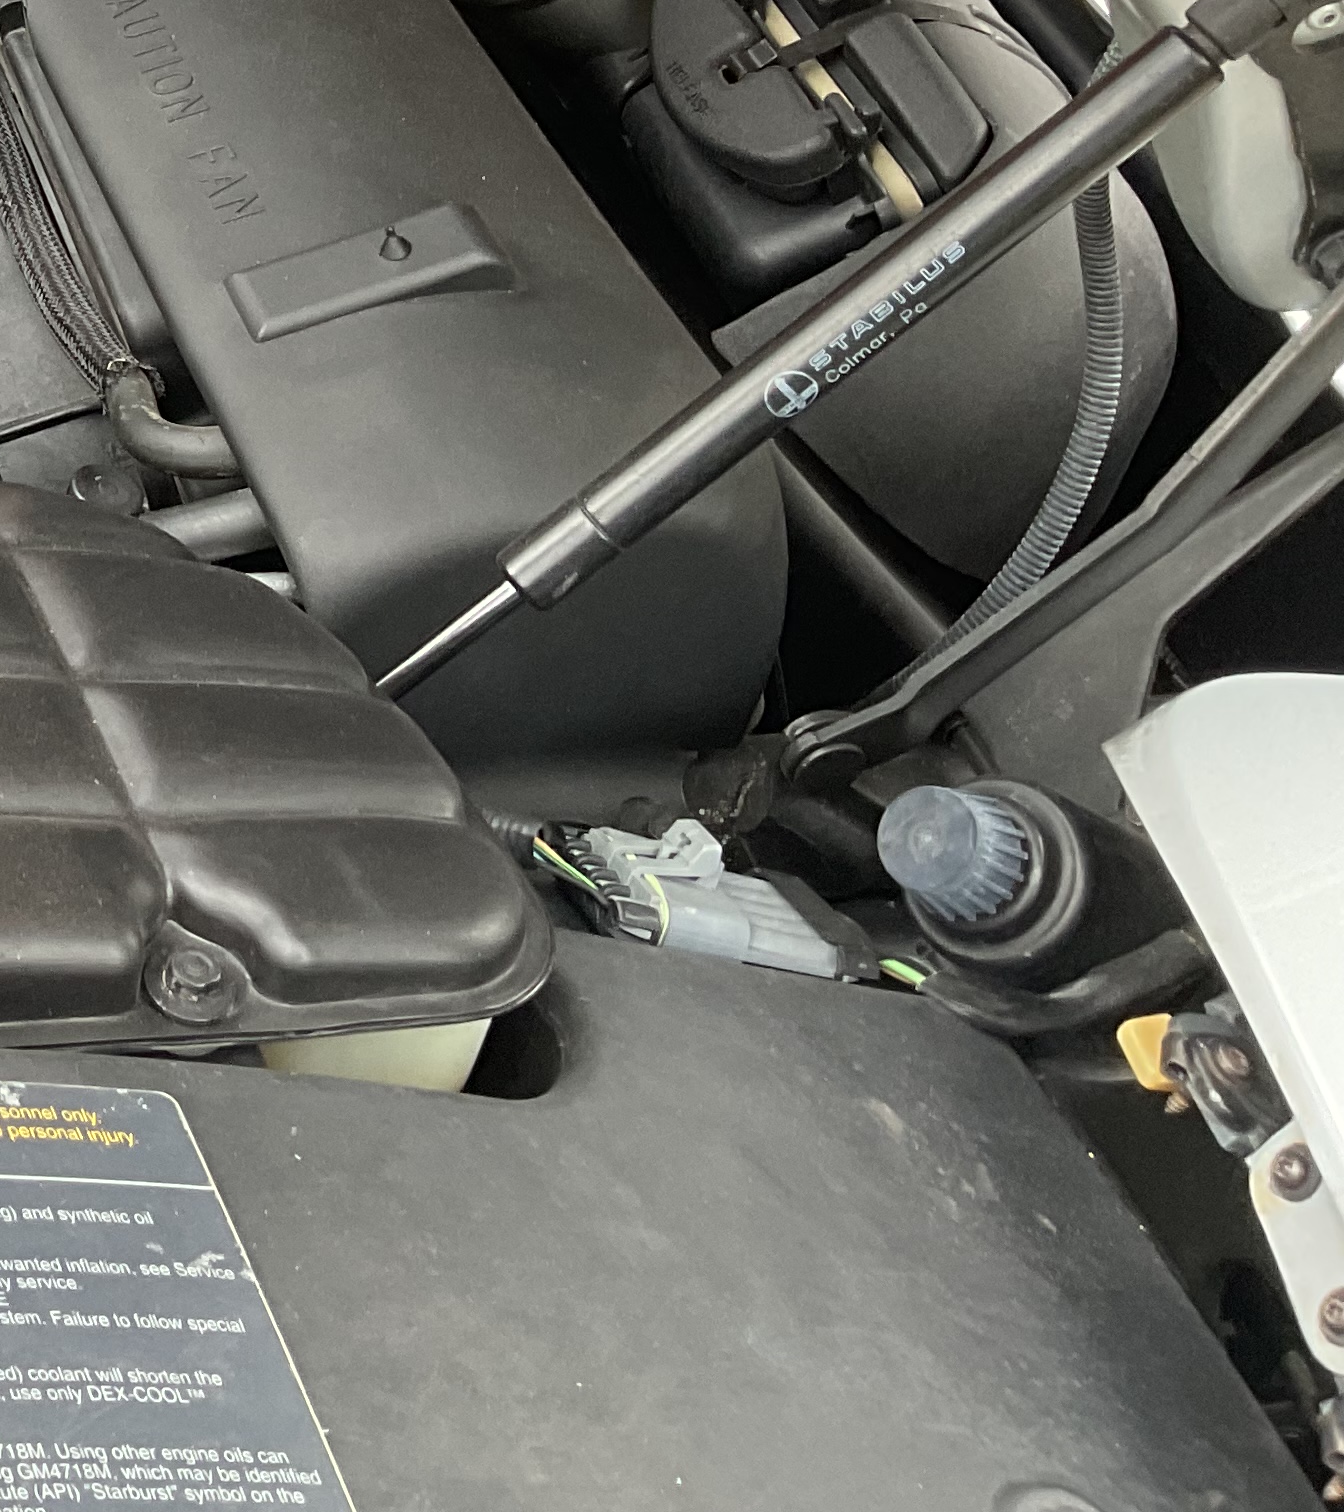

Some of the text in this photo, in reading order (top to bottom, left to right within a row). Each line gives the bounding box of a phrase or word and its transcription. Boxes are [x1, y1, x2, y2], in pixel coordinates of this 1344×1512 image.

[186, 142, 267, 226] FAN
[808, 240, 967, 373] STABILUS
[824, 299, 929, 385] Colmar, Pa
[7, 1123, 82, 1144] personal
